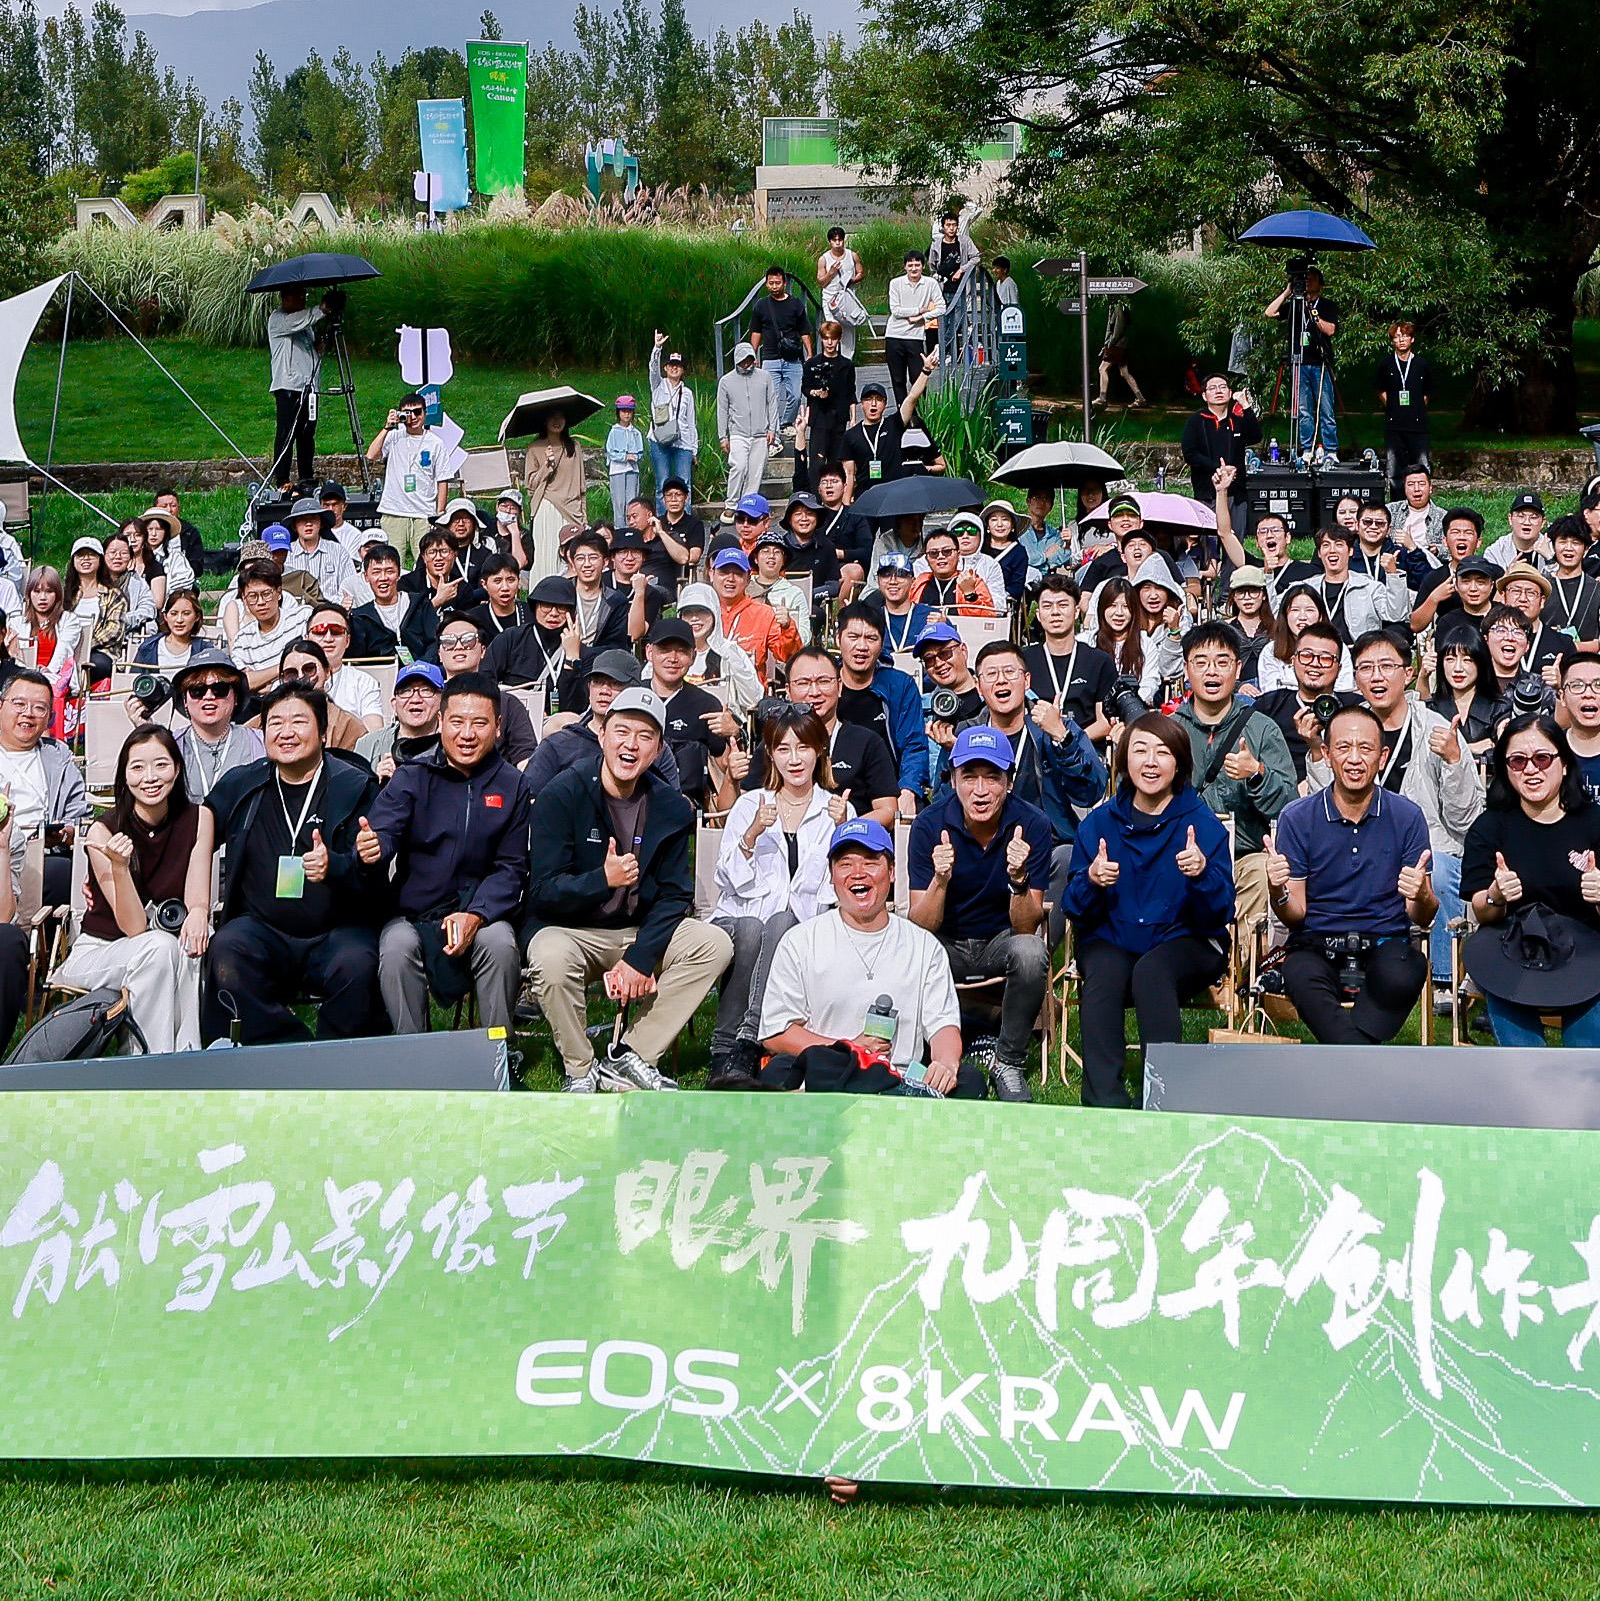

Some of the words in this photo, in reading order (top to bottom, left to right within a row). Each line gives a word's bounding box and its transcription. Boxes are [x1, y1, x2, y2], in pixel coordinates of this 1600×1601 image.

[487, 92, 516, 103] Canon
[612, 1147, 868, 1337] 眼界
[515, 1339, 740, 1417] EOS
[857, 1367, 1247, 1452] 8KRAW
